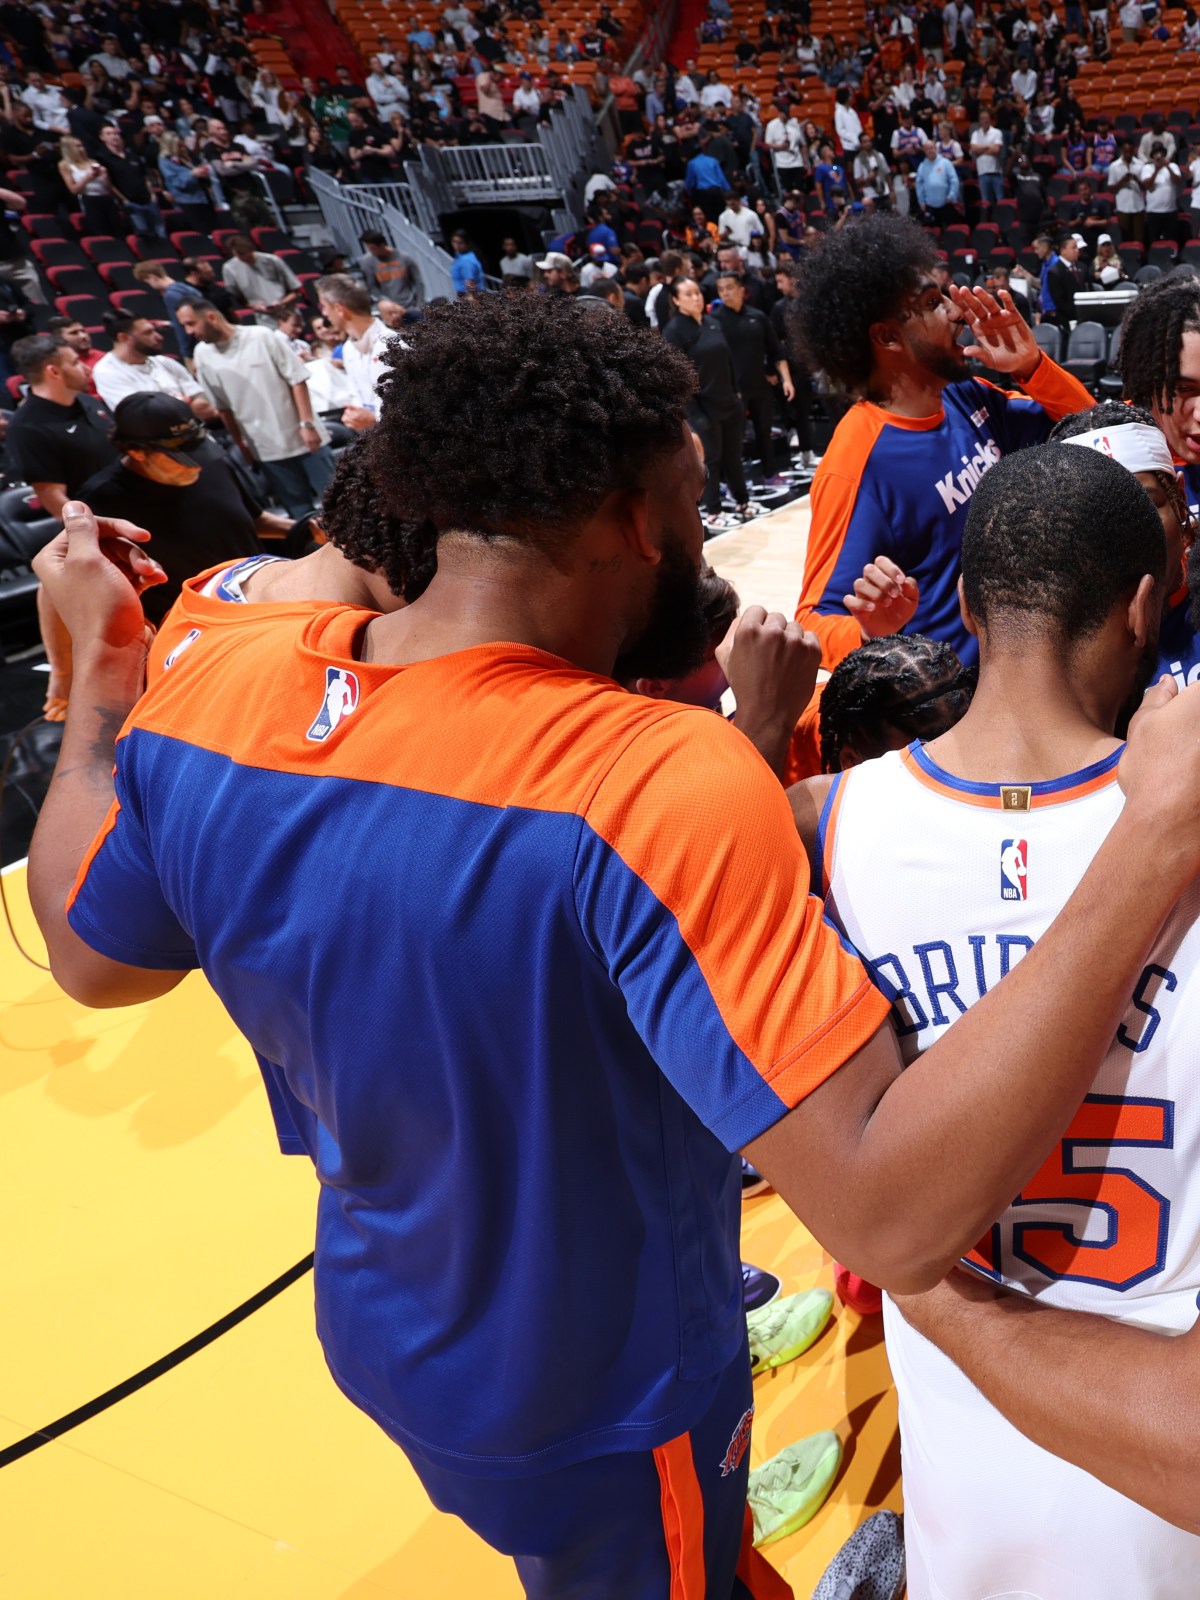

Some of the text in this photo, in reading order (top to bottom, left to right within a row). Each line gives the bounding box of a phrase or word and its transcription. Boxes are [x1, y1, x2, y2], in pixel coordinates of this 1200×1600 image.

[1011, 792, 1018, 806] 2
[1003, 888, 1018, 899] NBA
[868, 933, 1179, 1054] BRIS
[960, 1093, 1175, 1293] 5
